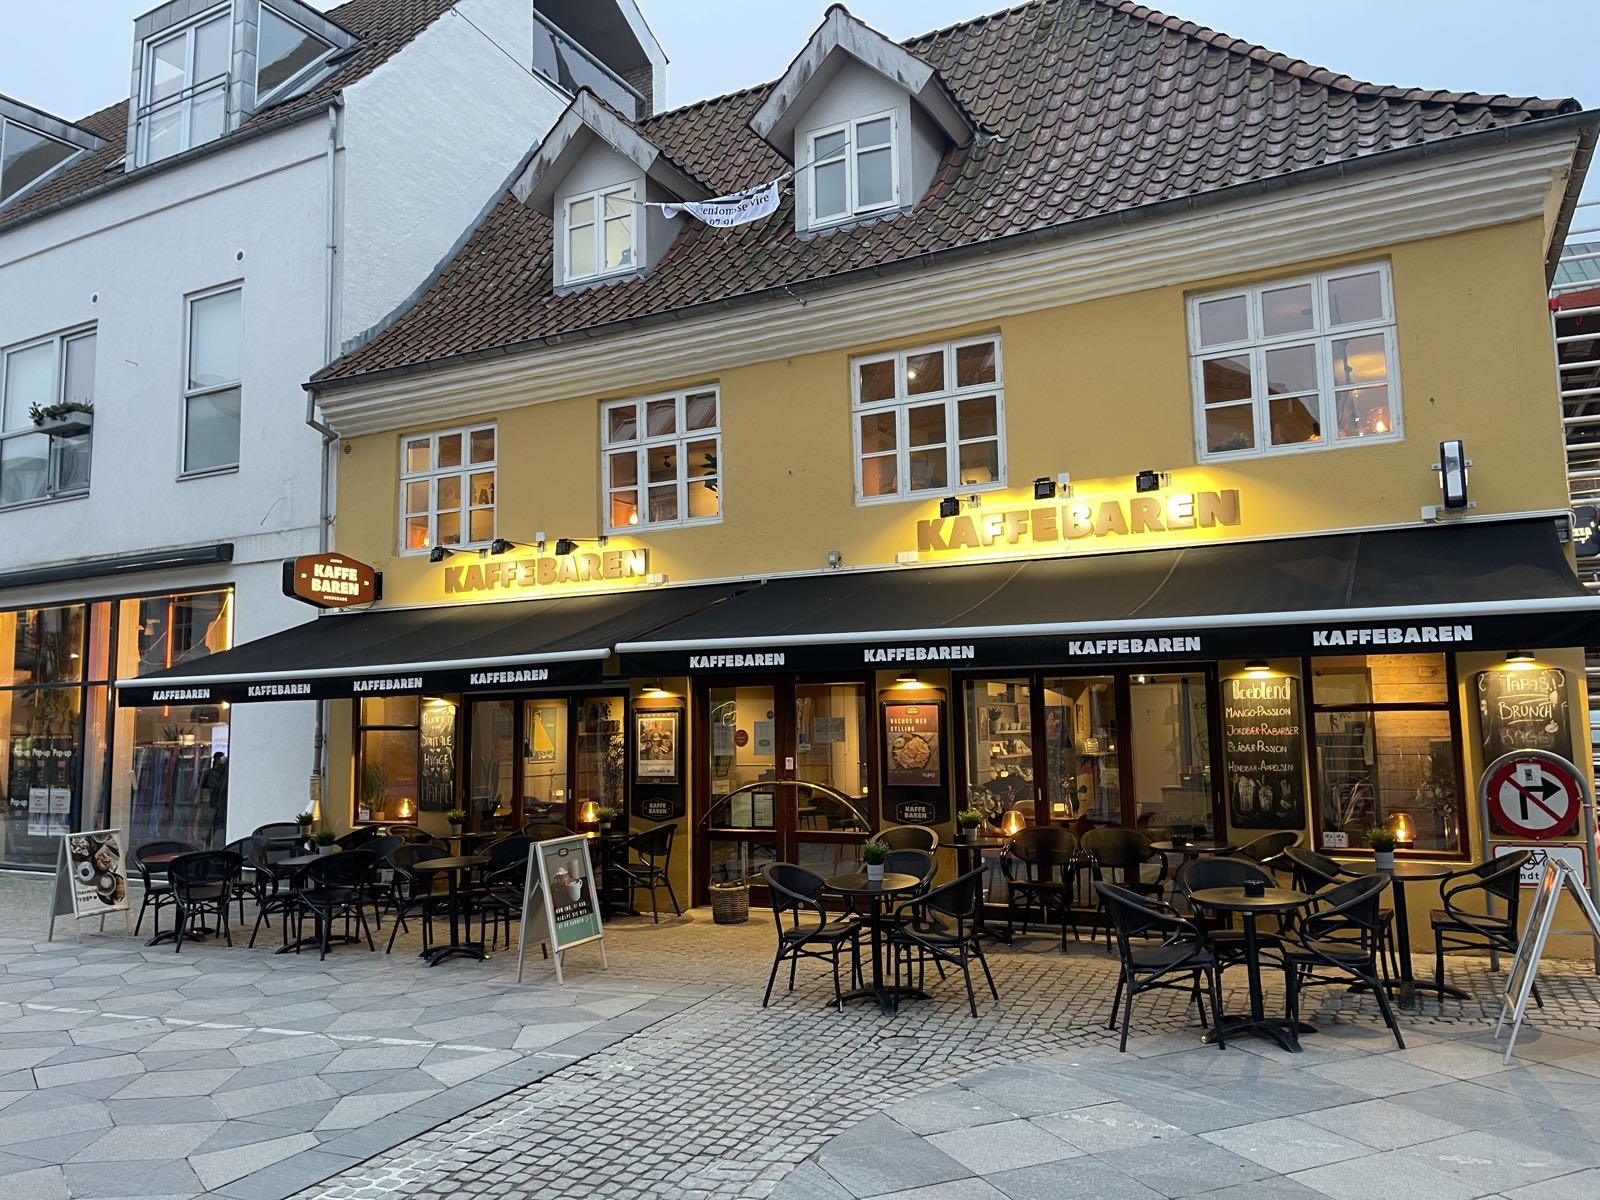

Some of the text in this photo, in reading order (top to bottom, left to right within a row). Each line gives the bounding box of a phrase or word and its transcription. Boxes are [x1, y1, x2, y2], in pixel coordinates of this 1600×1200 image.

[916, 489, 1241, 552] KAFFEBAREN
[314, 563, 358, 581] KAFFE
[444, 548, 650, 594] KAFFEBAREN
[311, 578, 359, 596] BAREN
[1313, 625, 1473, 646] KAFFEBAREN
[863, 645, 974, 662] KAFFEBAREN
[1068, 636, 1200, 655] KAFFEBAREN
[689, 653, 785, 668] KAFFEBAREN
[353, 677, 423, 692] KAFFEBAREN
[470, 669, 548, 685] KAFFEBAREN
[152, 688, 210, 701] KAFFEBAREN
[248, 683, 311, 697] KAFFEBAREN
[1233, 678, 1290, 700] Iceblend
[1225, 705, 1291, 718] MANGO-PASSION
[1498, 701, 1552, 720] BRUNCH
[32, 748, 51, 759] Pop-up
[52, 748, 72, 759] Pop-up
